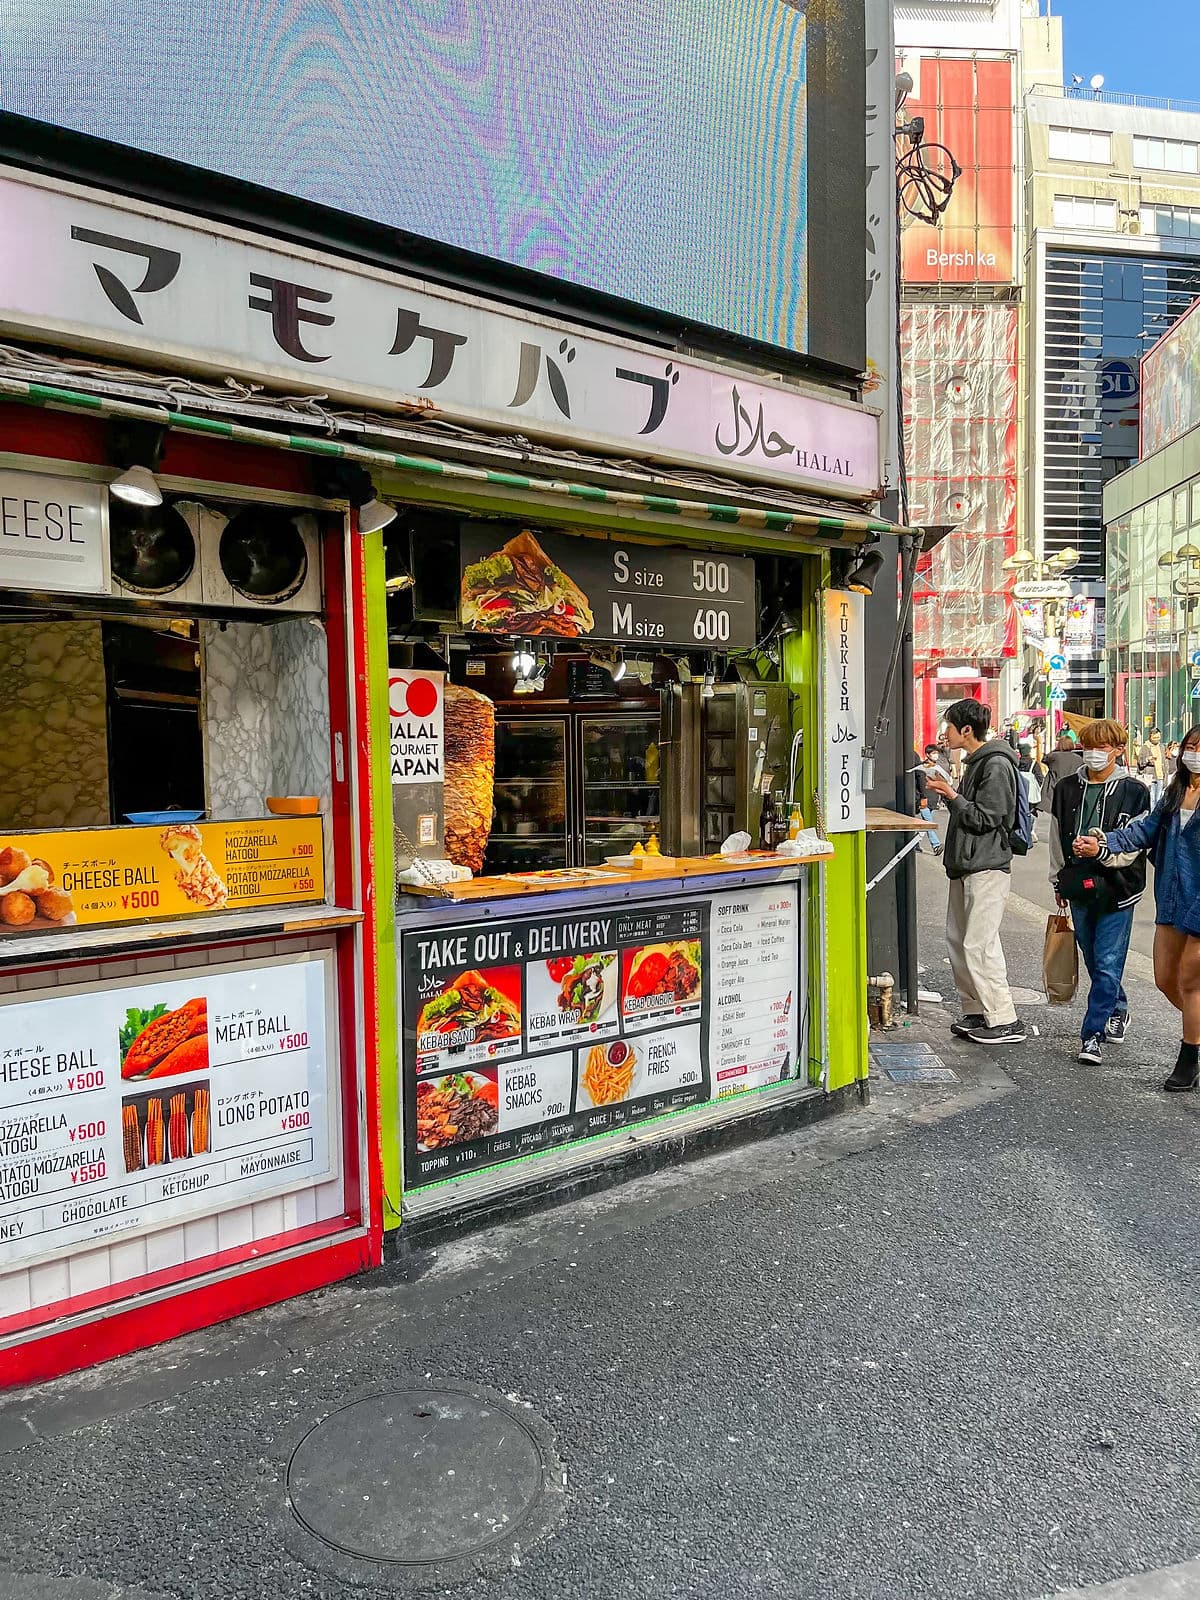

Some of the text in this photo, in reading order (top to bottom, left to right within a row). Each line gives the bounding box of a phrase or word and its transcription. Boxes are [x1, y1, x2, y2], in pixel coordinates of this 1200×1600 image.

[926, 248, 996, 266] Bershka
[70, 224, 681, 435] マモケバブ
[715, 384, 796, 458] حلال
[796, 450, 854, 477] HALAL
[2, 497, 85, 543] EESE
[613, 550, 730, 594] S size 500
[612, 601, 730, 641] M size 600
[840, 602, 850, 711] TURKISH
[831, 723, 858, 745] حلال
[390, 744, 438, 755] OURMET
[391, 758, 440, 777] APAN
[840, 754, 851, 821] FOOD
[225, 835, 278, 849] MOZZARELLA
[225, 844, 313, 861] HATOGU ¥500
[62, 866, 160, 891] CHEESE BALL
[226, 867, 310, 884] POTATO MOZZARELLA
[227, 879, 314, 897] HATOGU ¥550
[121, 890, 160, 909] ¥500
[718, 903, 750, 916] SOFT DRINK
[618, 919, 652, 932] ONLY MEAT
[721, 924, 743, 934] Coca Cola
[417, 919, 612, 970] TAKE OUT & DELIVERY
[721, 944, 732, 952] Coca
[418, 973, 446, 993] حلال
[624, 997, 645, 1011] KEBAB
[718, 993, 742, 1006] ALCOHOL
[215, 1008, 262, 1023] ミートボール
[529, 1009, 581, 1030] KEBAB WRAP
[216, 1015, 291, 1044] MEAT BALL
[420, 1028, 476, 1051] KEBAB SAND
[279, 1032, 308, 1050] ¥500
[3, 1045, 45, 1059] ズボール
[57, 1048, 98, 1073] BALL
[648, 1042, 677, 1061] FRENCH
[647, 1059, 670, 1077] FRIES
[67, 1070, 104, 1091] ¥500
[505, 1072, 537, 1093] KEBAB
[217, 1091, 264, 1107] ロングポテト
[218, 1090, 310, 1127] LONG POTATO
[505, 1090, 543, 1112] SNACKS
[0, 1113, 68, 1142] OZZARELLA
[281, 1111, 310, 1131] ¥500
[589, 1113, 607, 1127] SAUCE
[68, 1120, 106, 1142] ¥500
[521, 1134, 542, 1145] AVOCADO
[493, 1141, 512, 1153] CHEESE
[0, 1147, 106, 1185] TATO MOZZARELLA
[240, 1149, 301, 1176] MAYONNAISE
[421, 1156, 449, 1173] TOPPING
[71, 1162, 106, 1184] ¥550
[162, 1173, 210, 1197] KETCHUP
[62, 1195, 128, 1223] CHOCOLATE
[0, 1222, 24, 1239] NEY
